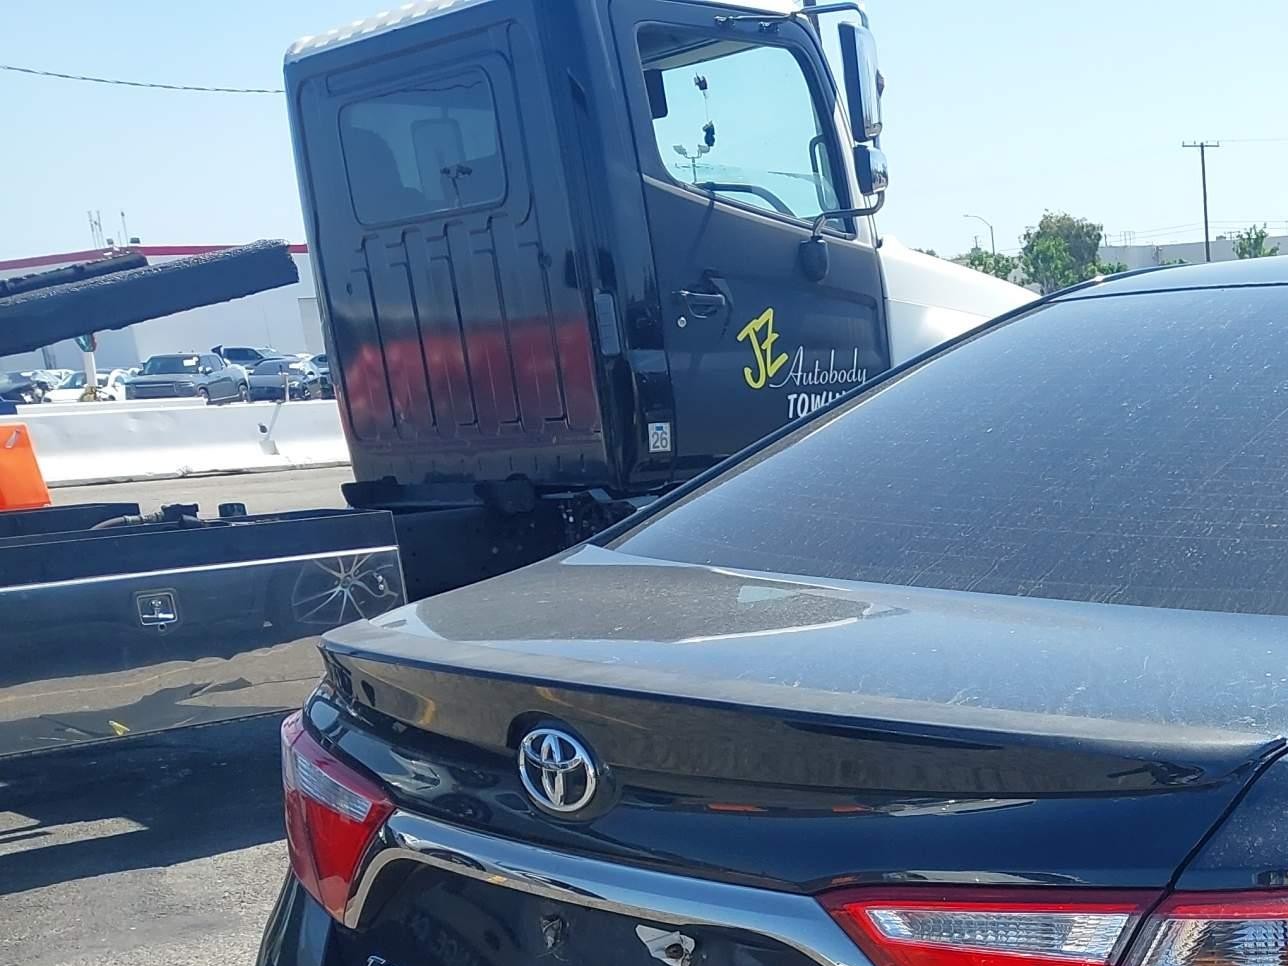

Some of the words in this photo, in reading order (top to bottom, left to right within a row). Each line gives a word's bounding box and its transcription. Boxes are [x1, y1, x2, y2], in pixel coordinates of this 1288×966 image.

[769, 345, 868, 389] Autobody
[787, 390, 847, 419] TOW
[651, 431, 669, 449] 26
